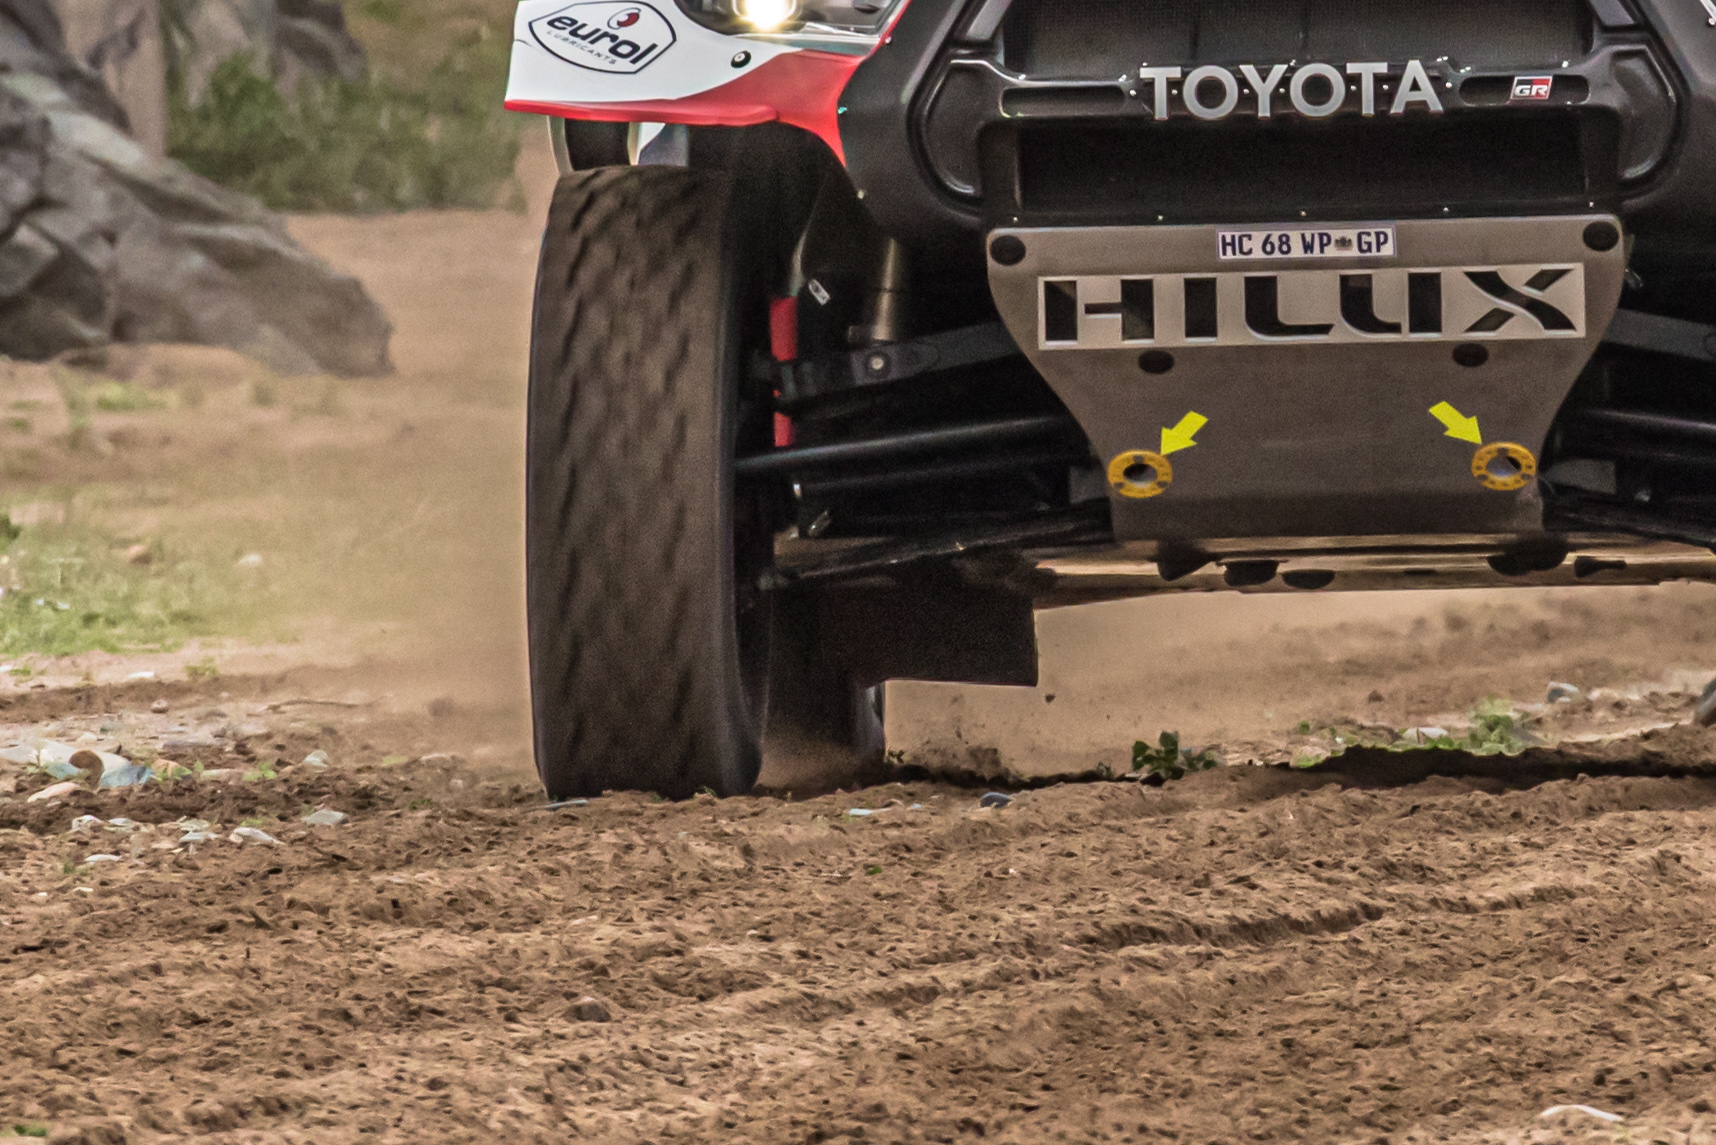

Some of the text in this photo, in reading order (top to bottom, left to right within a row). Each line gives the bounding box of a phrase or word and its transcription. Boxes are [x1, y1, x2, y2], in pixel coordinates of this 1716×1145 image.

[546, 15, 659, 65] eurol
[1139, 59, 1444, 120] TOYOTA
[1513, 80, 1549, 98] GR
[1221, 230, 1389, 256] HC 68 WP GP
[1043, 267, 1577, 343] HILUX
